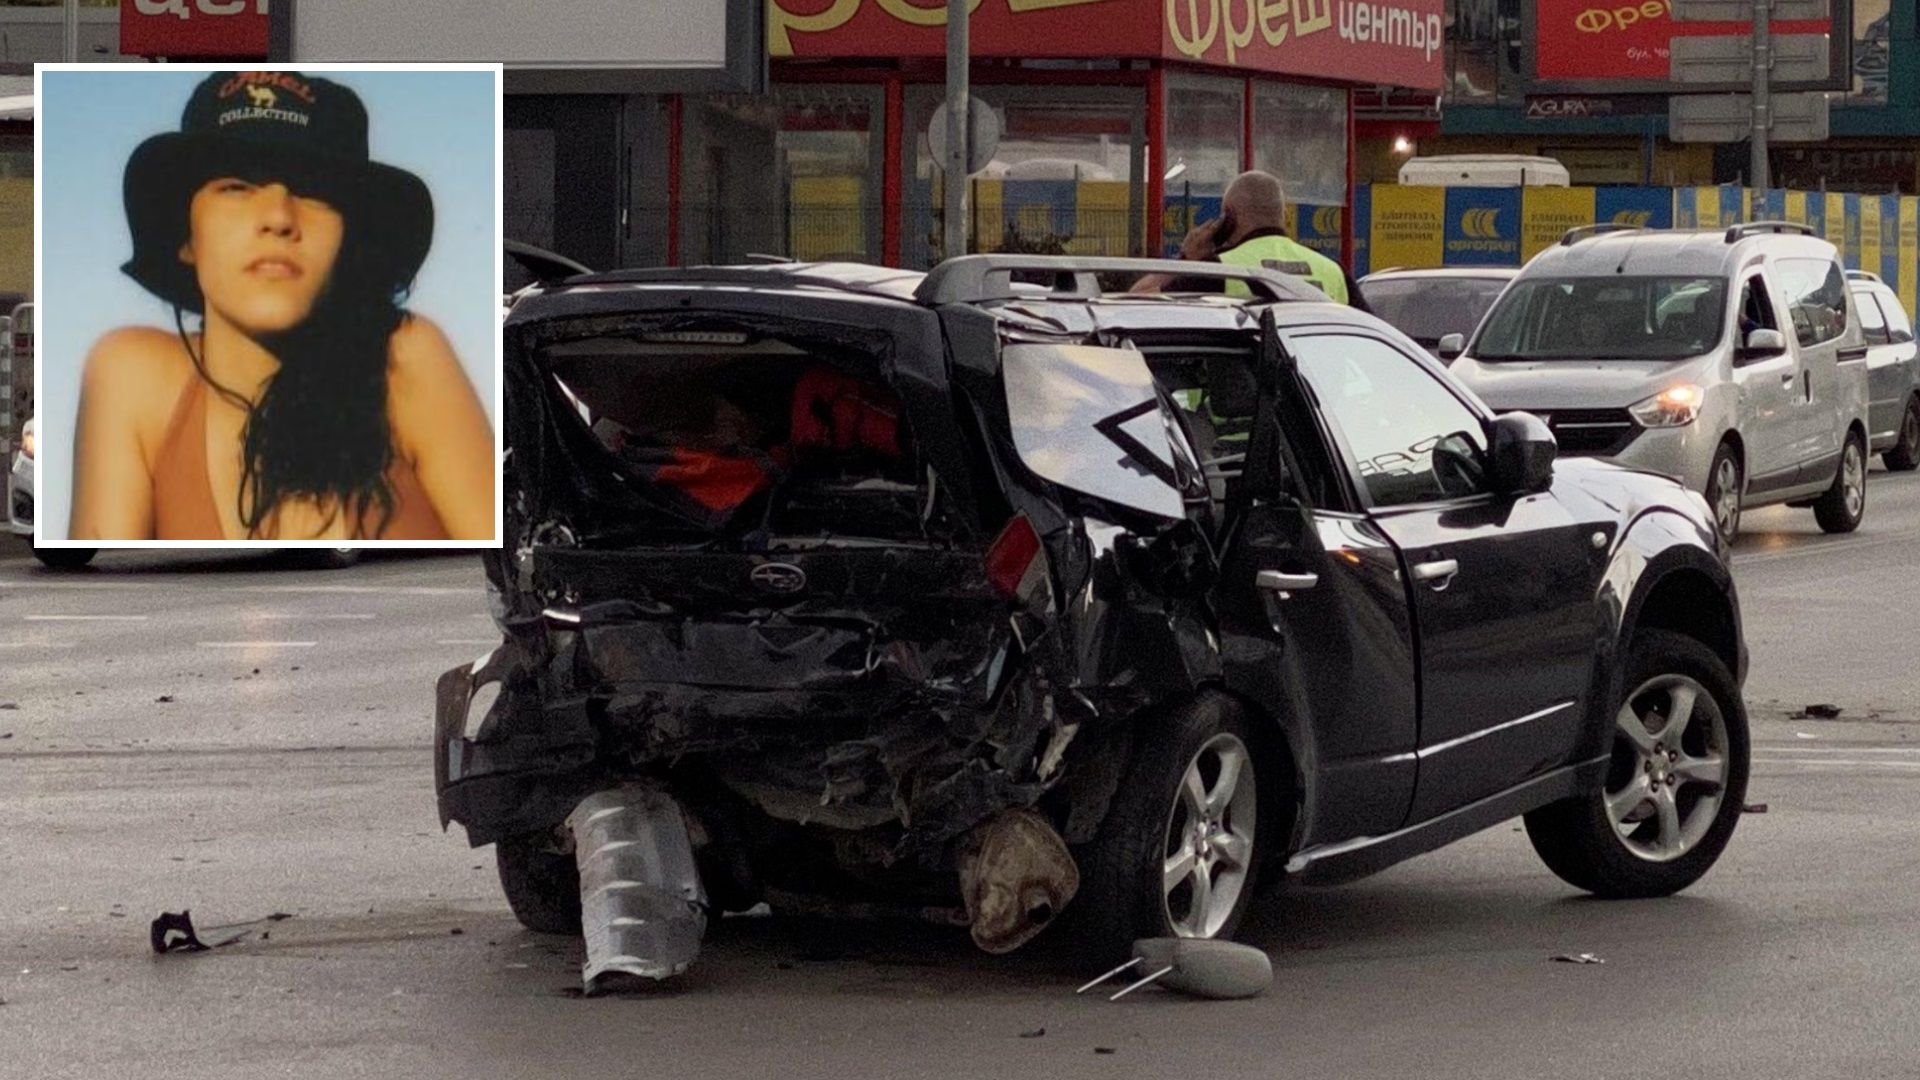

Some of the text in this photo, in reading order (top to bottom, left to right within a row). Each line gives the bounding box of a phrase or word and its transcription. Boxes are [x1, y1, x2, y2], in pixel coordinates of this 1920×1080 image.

[1166, 0, 1332, 64] Фреш
[1338, 1, 1441, 62] център
[1575, 0, 1671, 33] Фре
[218, 107, 309, 128] COLLECTION
